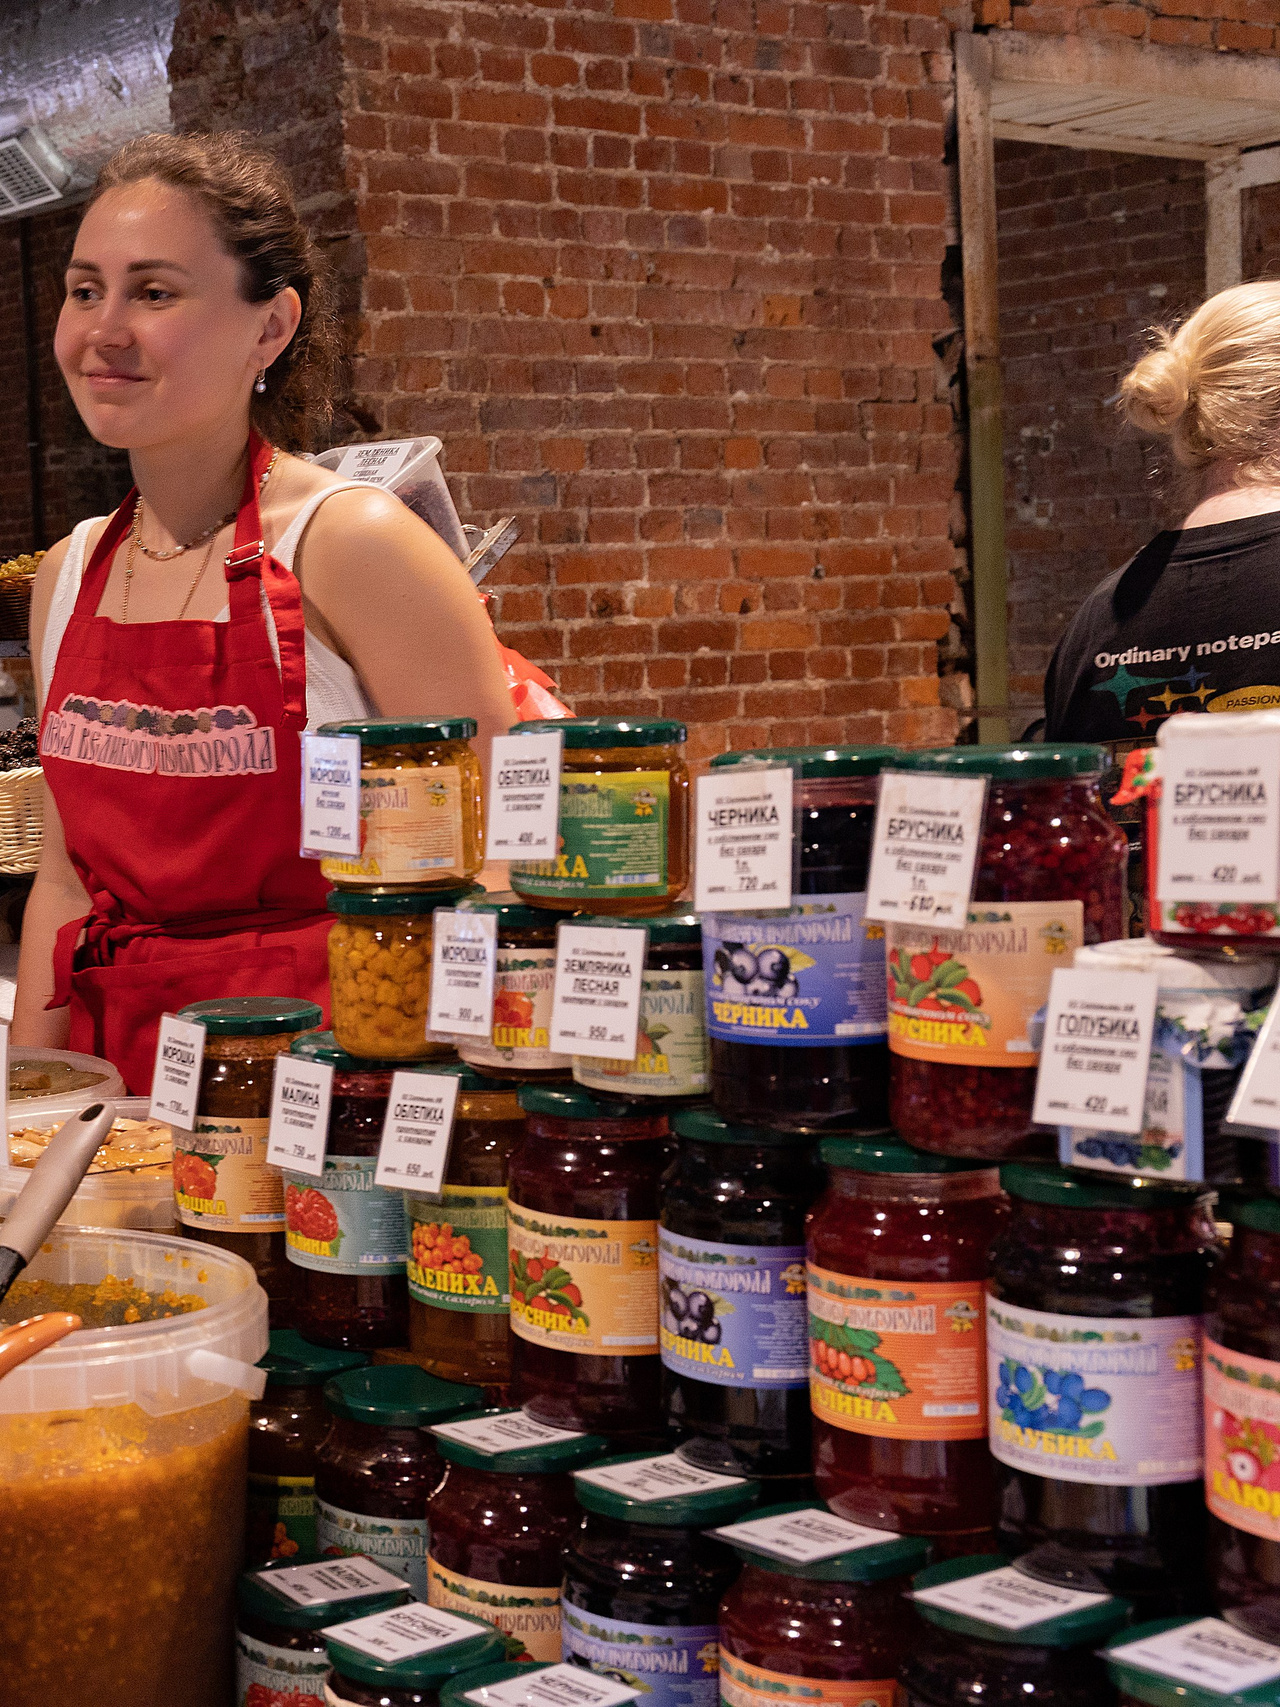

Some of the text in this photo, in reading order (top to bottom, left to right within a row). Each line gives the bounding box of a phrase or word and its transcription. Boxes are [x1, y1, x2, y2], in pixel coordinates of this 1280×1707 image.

[1094, 645, 1191, 669] Ordinary
[310, 767, 351, 784] МОРОШКА
[498, 768, 551, 786] ОБЛЕПИХА
[1175, 783, 1266, 805] БРУСНИКА
[708, 806, 779, 826] ЧЕРНИКА
[888, 818, 964, 842] БРУСНИКА
[740, 876, 758, 890] 720
[442, 946, 486, 962] МОРОШКА
[564, 959, 631, 976] ЗЕМЛЯНИКА
[573, 978, 619, 994] ЛЕСНАЯ
[589, 1025, 607, 1038] 950
[1057, 1014, 1139, 1038] ГОЛУБИКА
[163, 1045, 195, 1065] МОРОШКА
[282, 1087, 320, 1107] МАЛИНА
[394, 1104, 443, 1121] ОБЛЕПИХА
